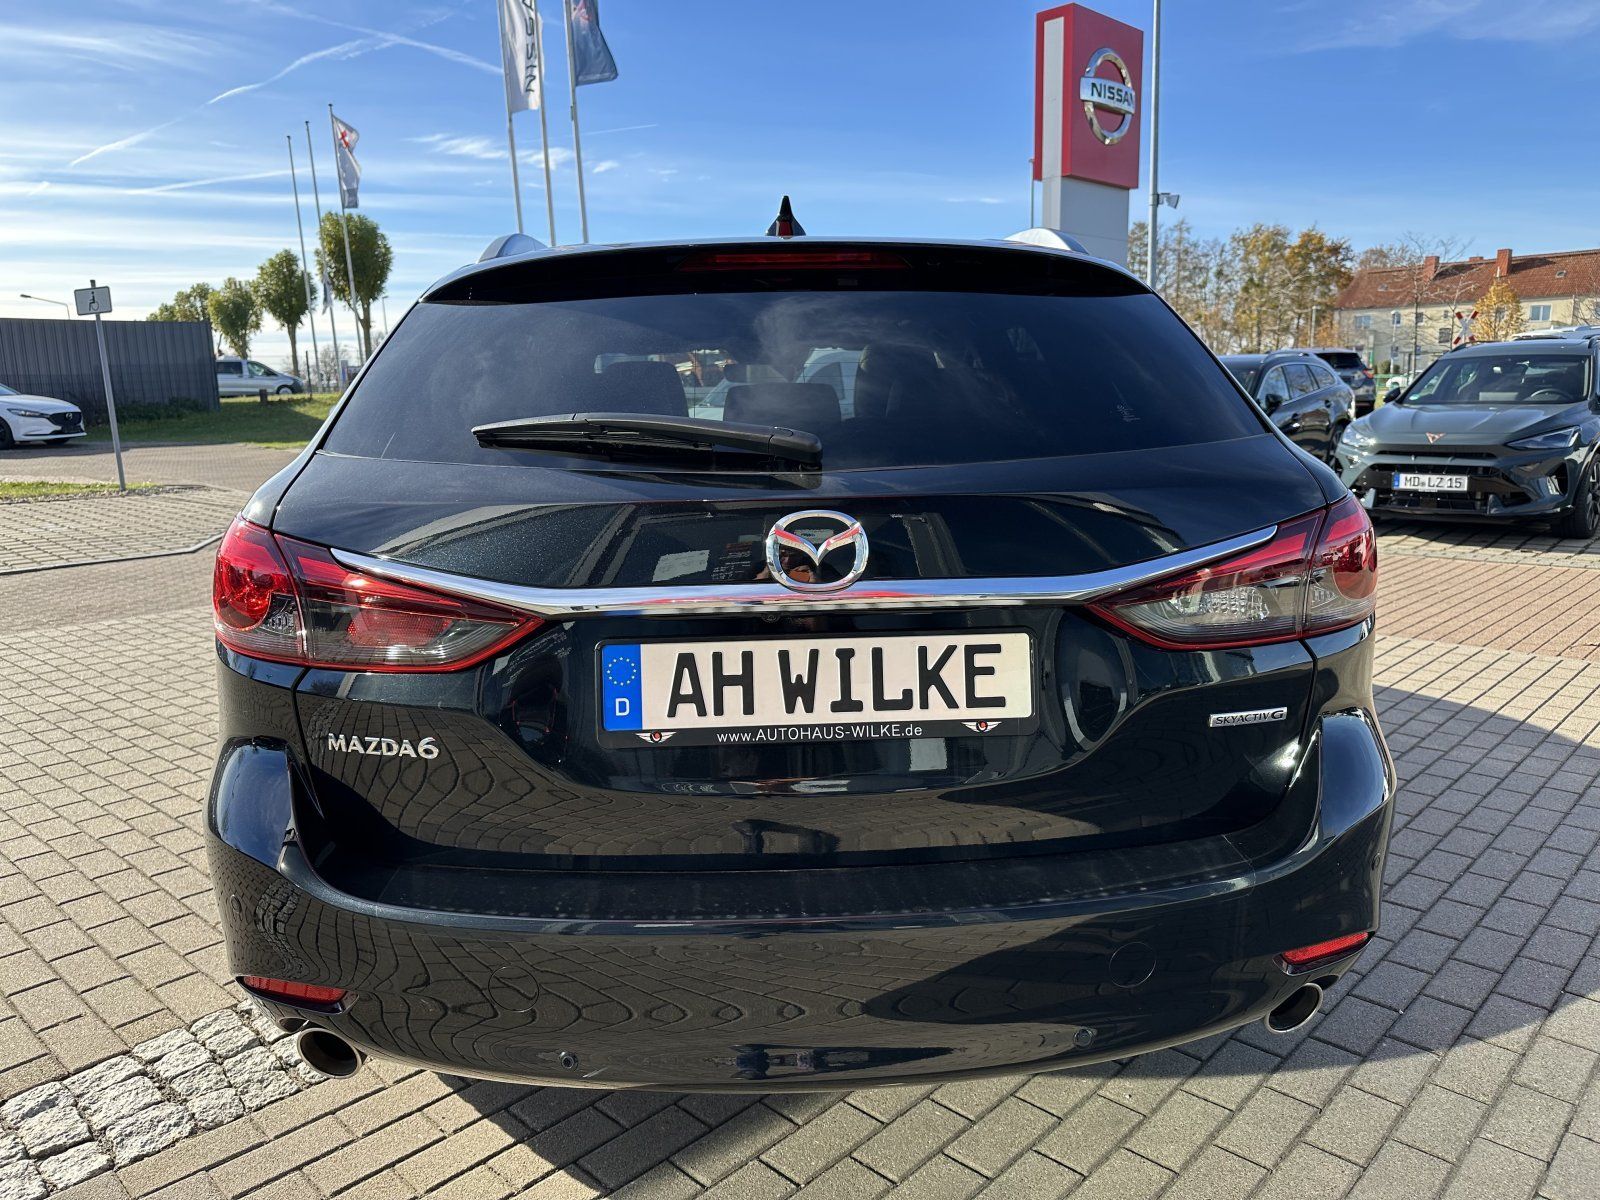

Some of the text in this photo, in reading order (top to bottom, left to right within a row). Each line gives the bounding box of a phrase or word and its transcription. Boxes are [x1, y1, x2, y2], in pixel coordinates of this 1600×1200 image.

[1404, 476, 1462, 489] MD LZ 15
[667, 643, 1007, 718] AH WILKE
[615, 698, 630, 716] D
[716, 723, 924, 744] www.AUTOHAUS-WILKE.de
[328, 733, 440, 760] MAZDA6
